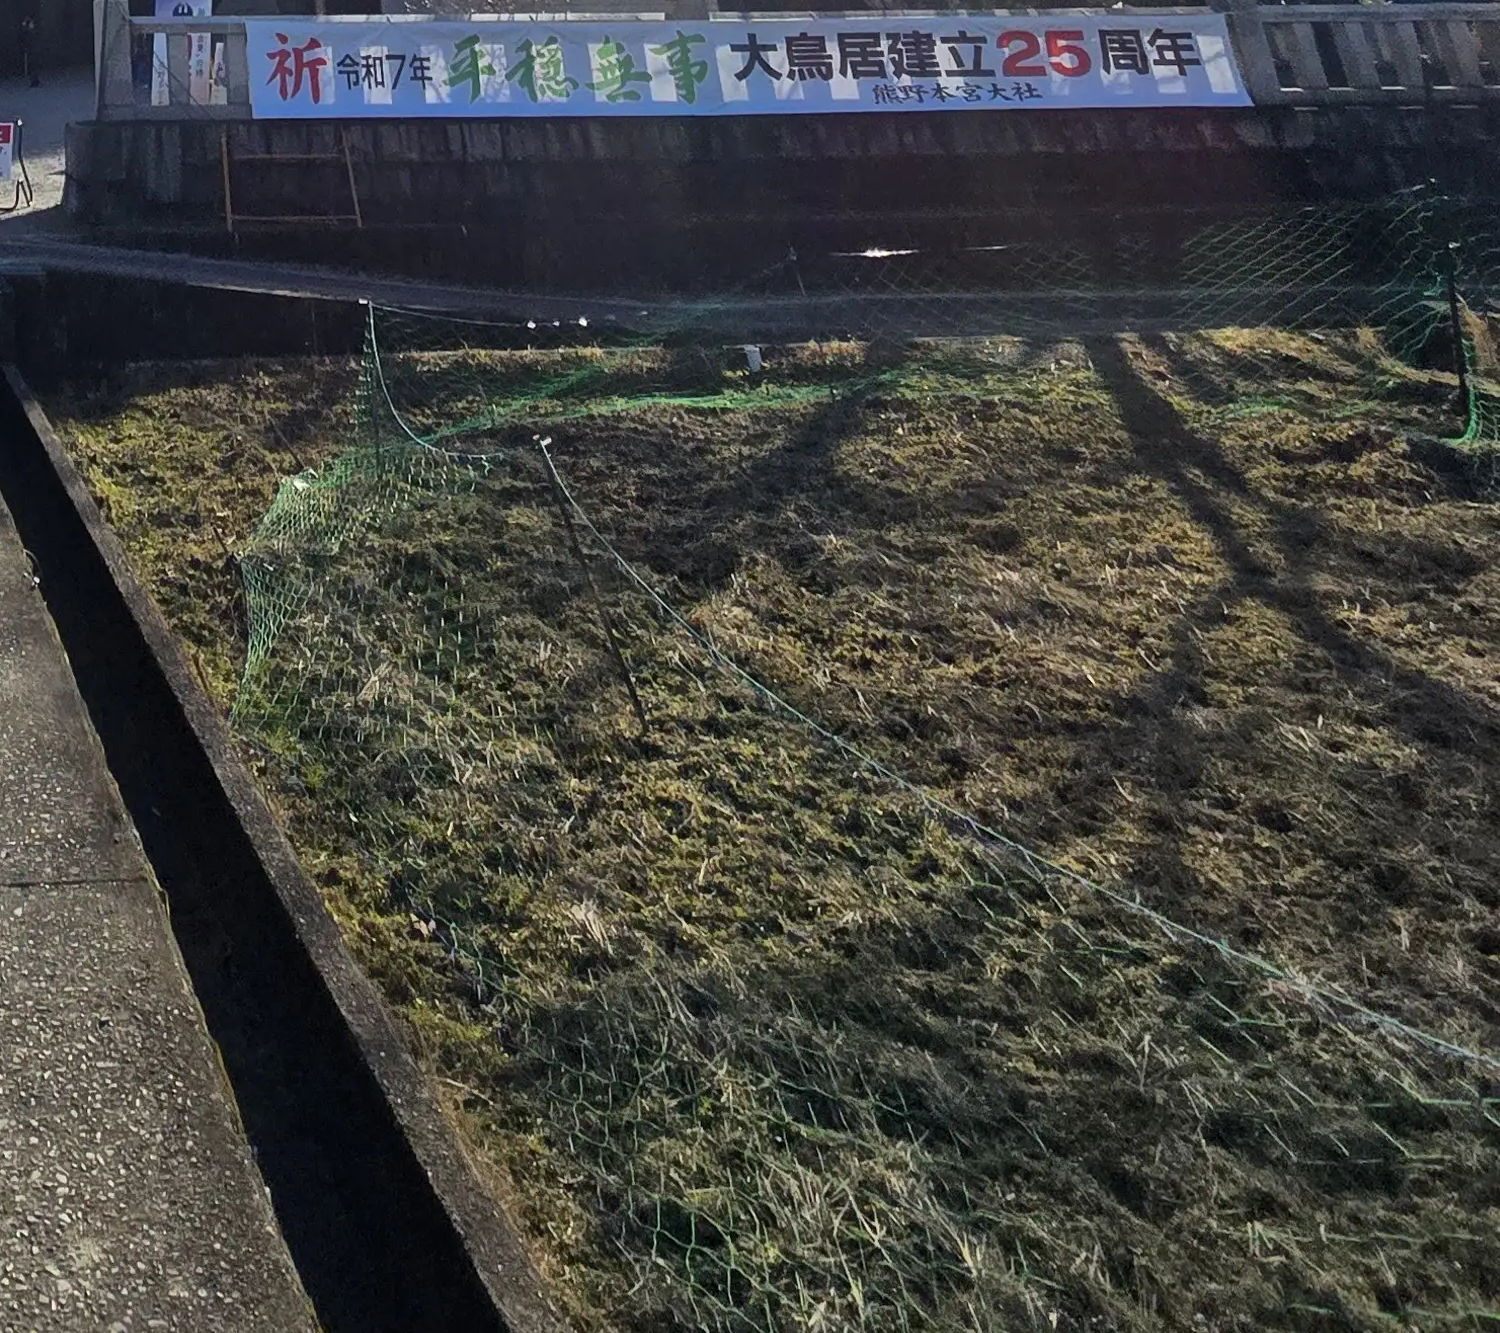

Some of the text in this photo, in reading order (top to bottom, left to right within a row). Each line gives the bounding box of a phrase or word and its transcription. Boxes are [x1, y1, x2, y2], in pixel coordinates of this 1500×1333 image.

[266, 32, 327, 104] 祈
[336, 53, 433, 91] 令和7年
[443, 30, 708, 104] 平穏無事
[729, 29, 1203, 82] 大鳥居建立25周年
[872, 81, 1043, 106] 熊野本宮大社
